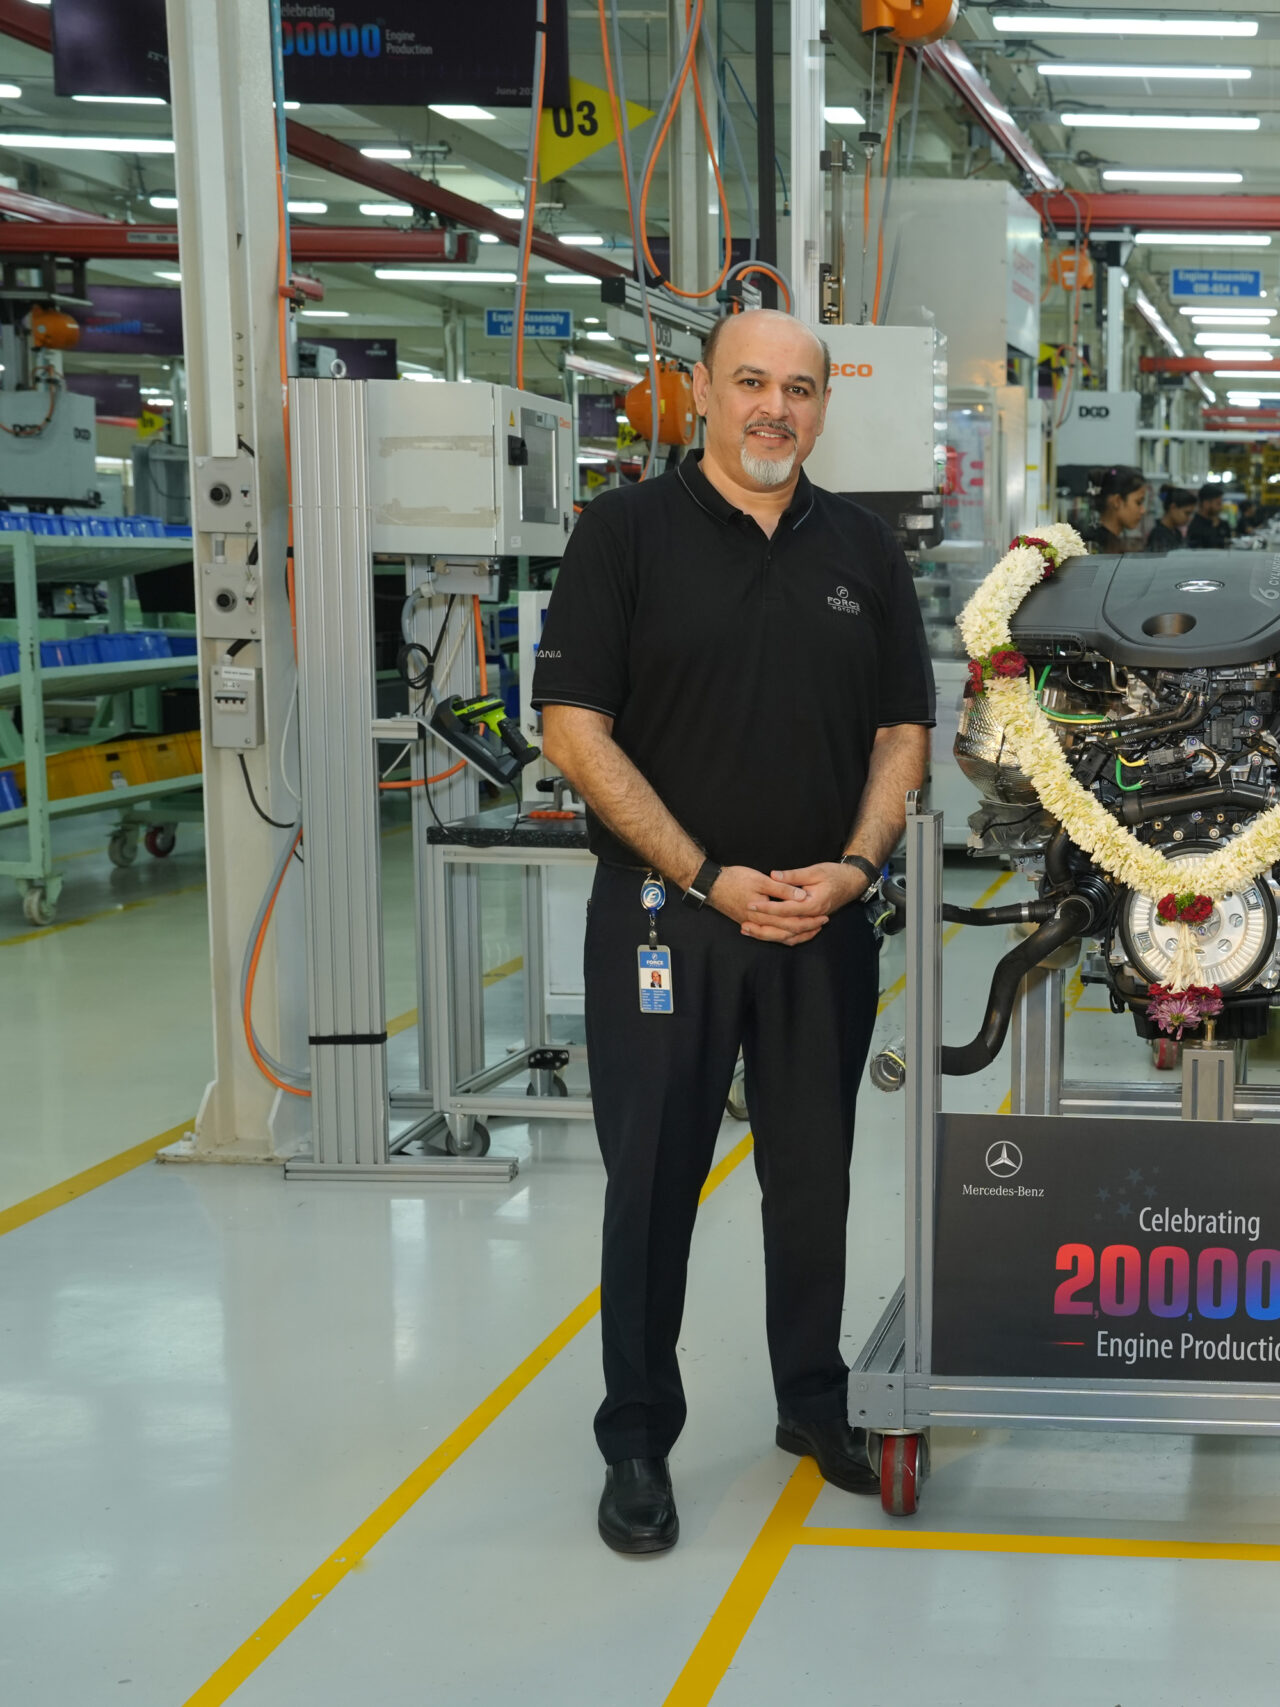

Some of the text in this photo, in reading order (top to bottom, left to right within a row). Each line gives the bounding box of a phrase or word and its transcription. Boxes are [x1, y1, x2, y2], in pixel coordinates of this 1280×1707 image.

[281, 4, 335, 21] elebrating
[281, 21, 381, 58] 00000
[385, 29, 416, 42] Engine
[385, 43, 433, 55] Production
[496, 87, 517, 96] June
[552, 100, 599, 138] 03
[492, 312, 514, 323] Engi
[830, 363, 873, 377] eco
[1078, 405, 1110, 418] DGD
[1258, 587, 1280, 600] 6
[962, 1184, 1045, 1198] Mercedes-Benz
[1139, 1207, 1261, 1241] Celebrating
[1096, 1330, 1173, 1365] Engine
